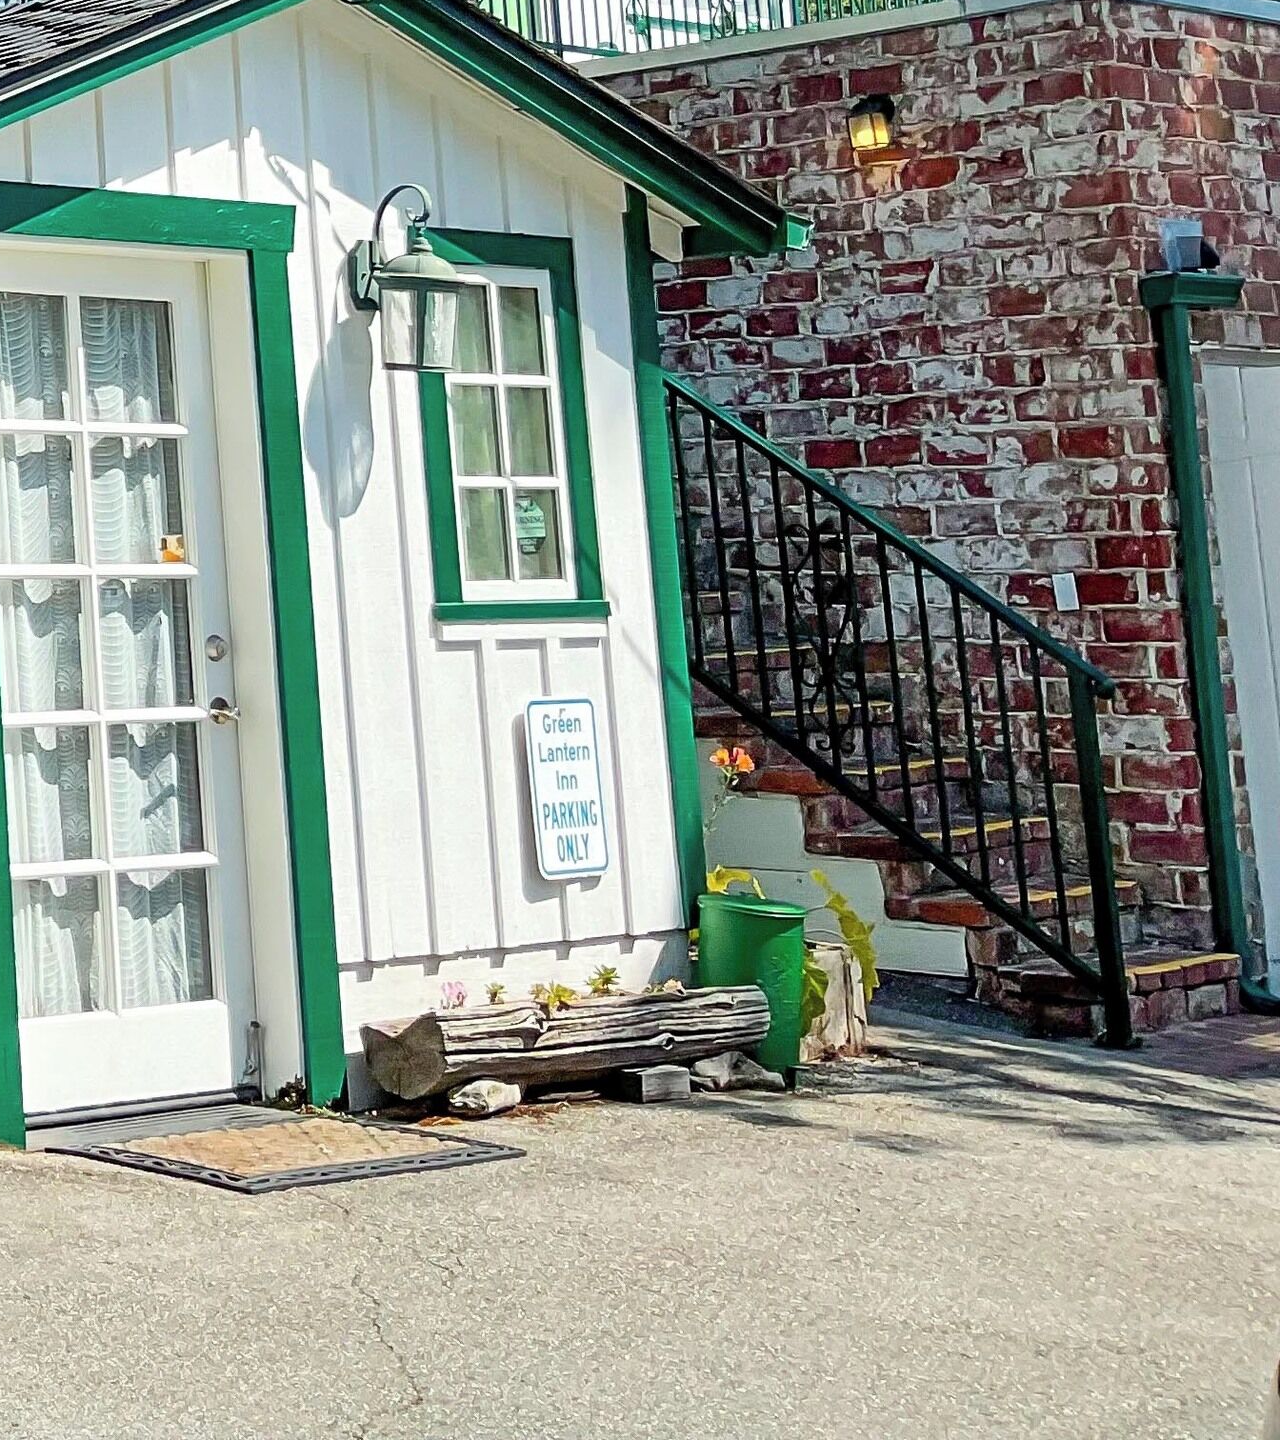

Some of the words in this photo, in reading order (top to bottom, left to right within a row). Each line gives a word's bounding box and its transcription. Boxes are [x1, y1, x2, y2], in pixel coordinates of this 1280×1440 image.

[543, 714, 581, 734] Green
[538, 743, 590, 762] Lantern
[556, 771, 578, 790] Inn
[543, 800, 597, 830] PARKING
[557, 833, 589, 862] ONLY
